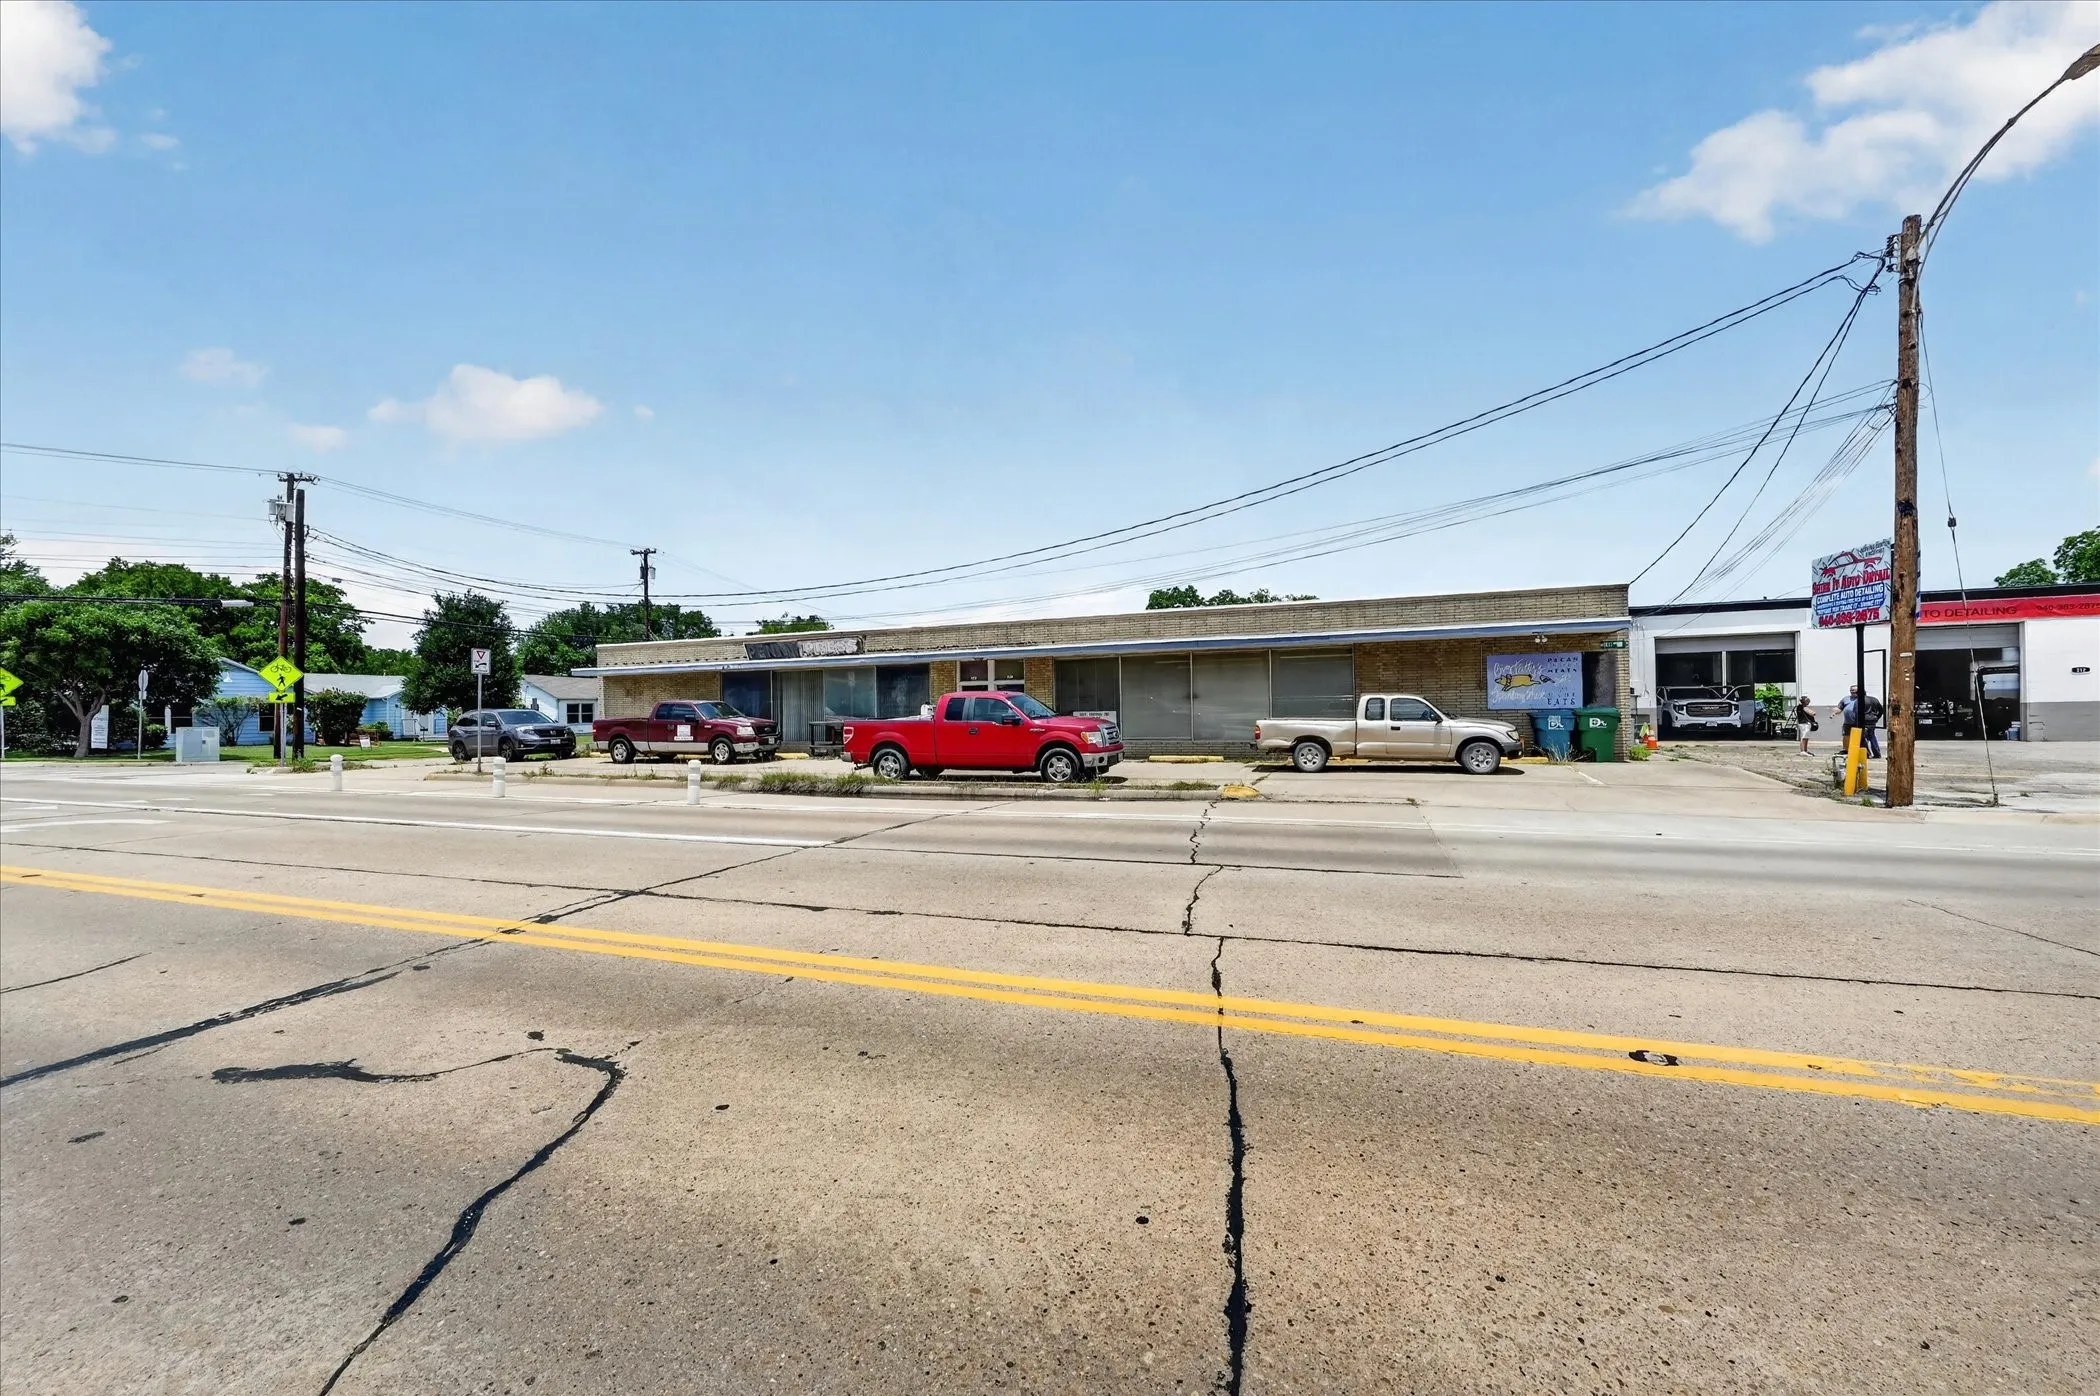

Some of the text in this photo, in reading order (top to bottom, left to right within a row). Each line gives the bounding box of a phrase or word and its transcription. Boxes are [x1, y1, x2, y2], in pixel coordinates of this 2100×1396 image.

[1816, 594, 1840, 604] COMPLETE
[1841, 590, 1854, 599] AUTO
[1855, 585, 1883, 596] DETAILING
[1944, 606, 2017, 618] DETAILING
